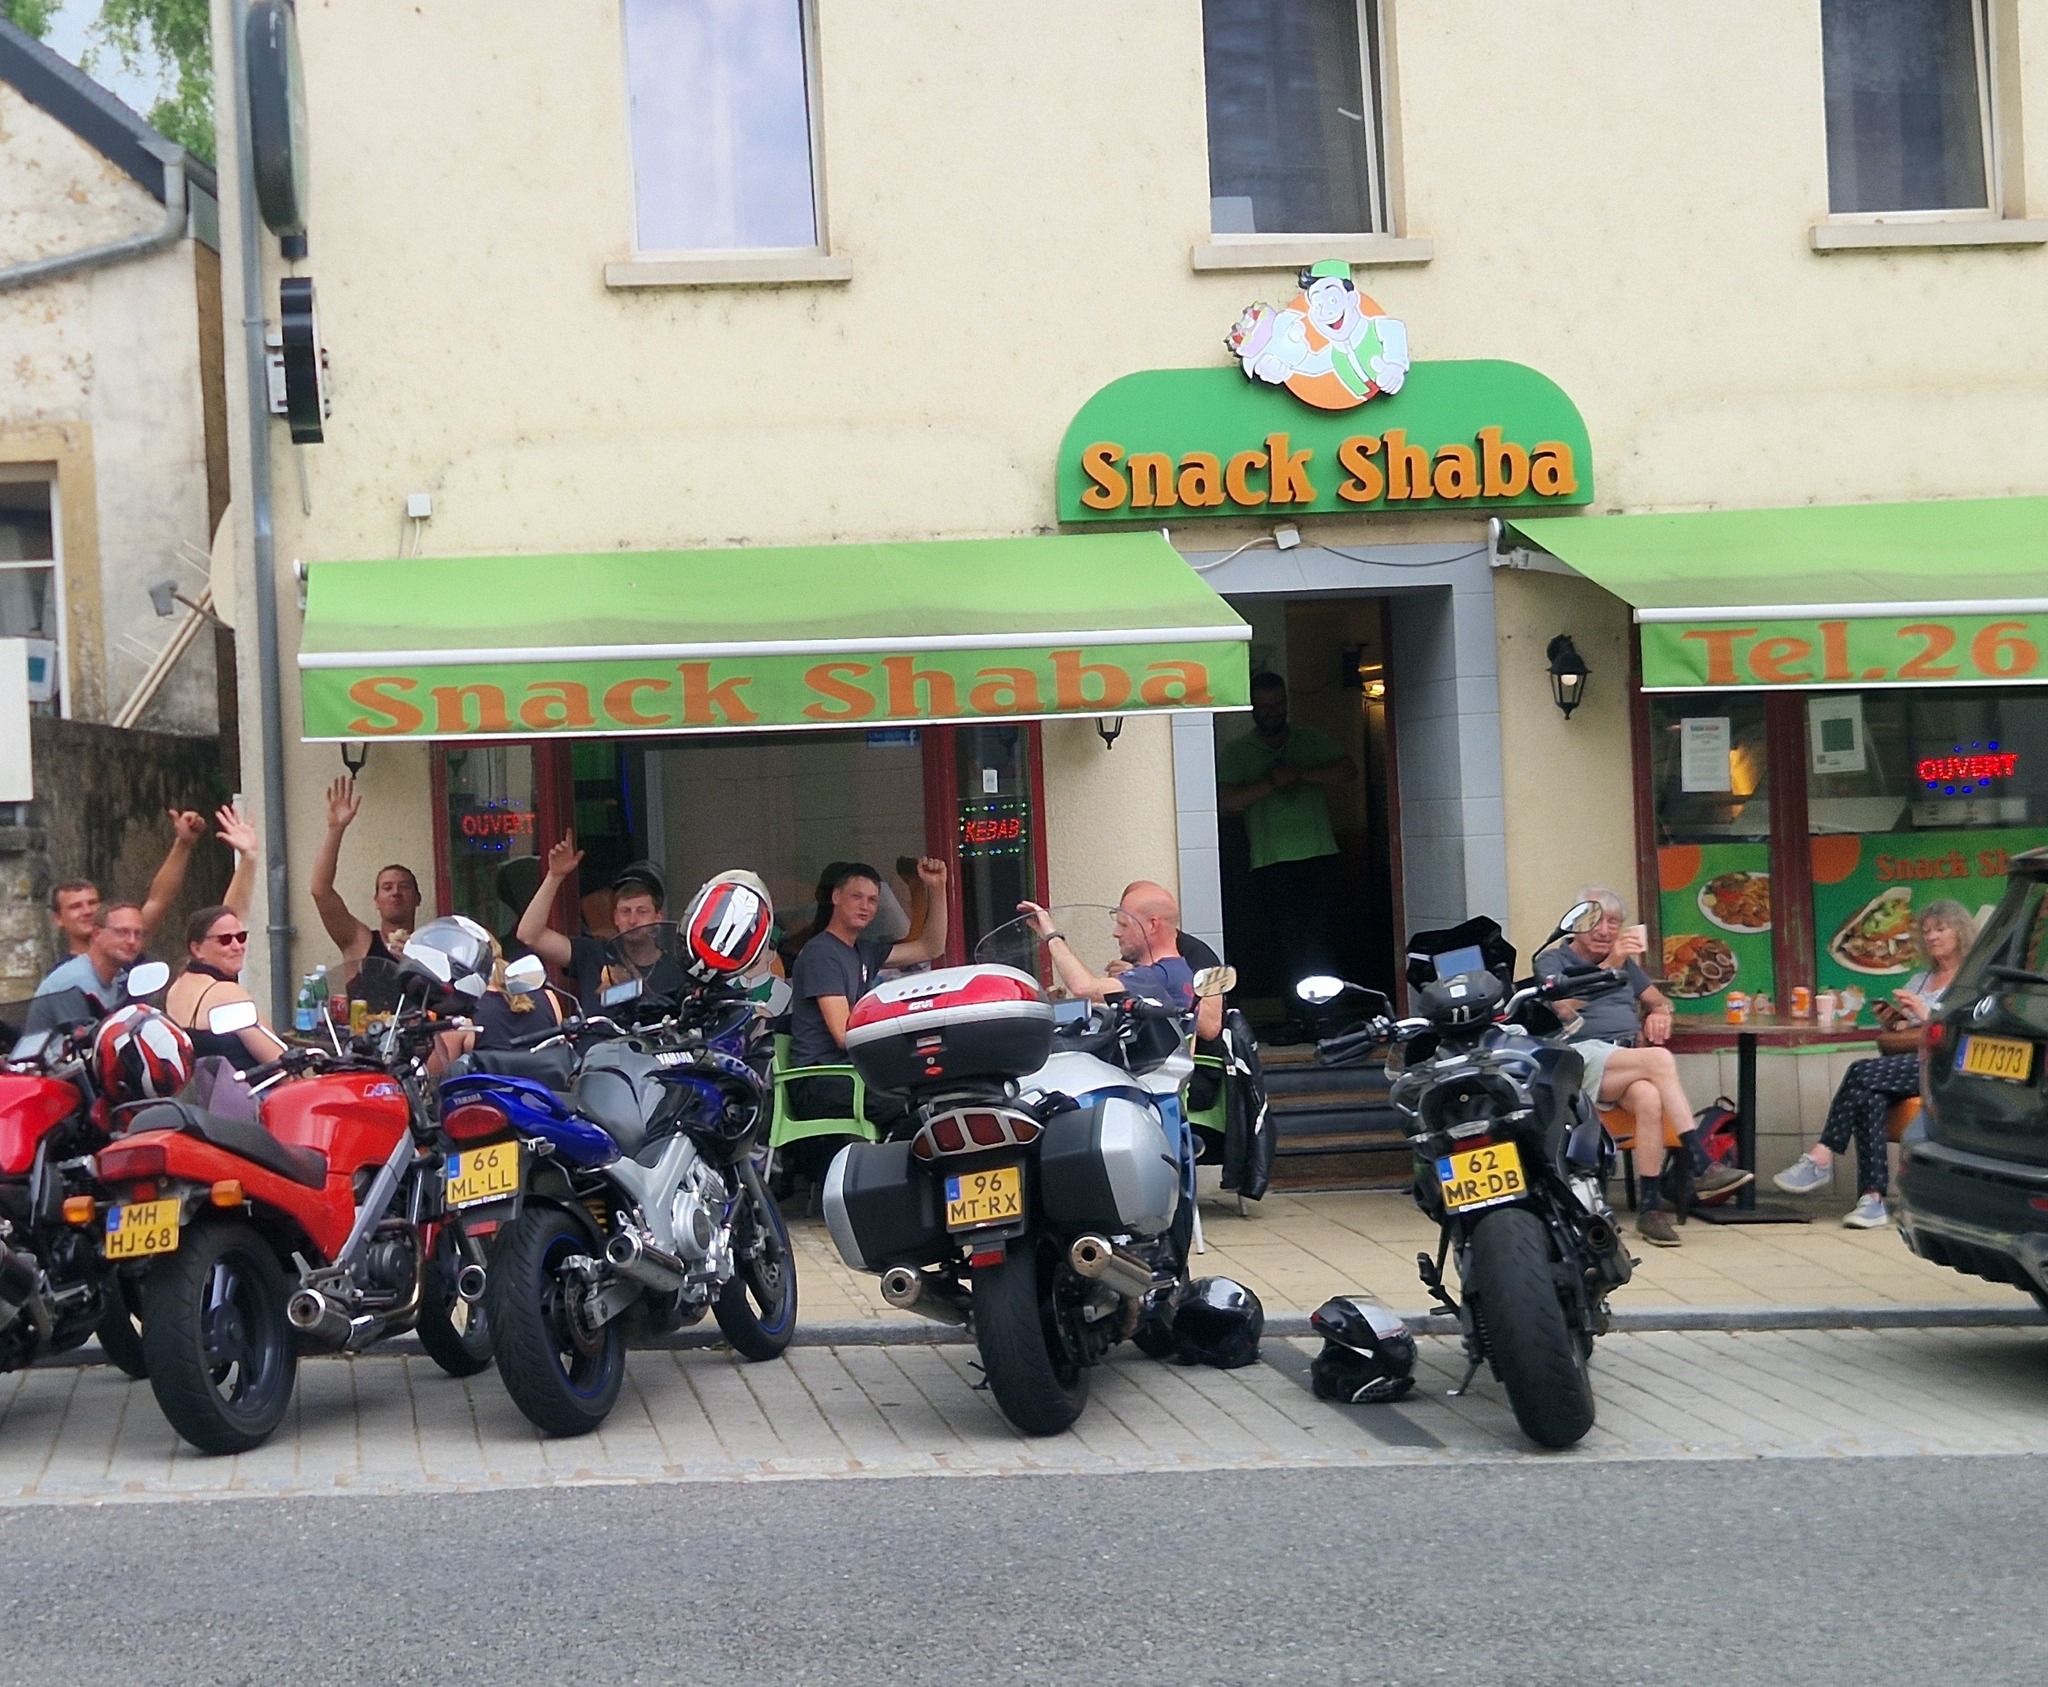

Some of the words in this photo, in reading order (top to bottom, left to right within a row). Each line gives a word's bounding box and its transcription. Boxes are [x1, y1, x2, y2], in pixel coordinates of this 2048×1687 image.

[1081, 432, 1317, 510] Snack
[1337, 425, 1578, 502] Shaba
[347, 661, 760, 735] Snack
[802, 650, 1214, 720] Shaba
[1918, 752, 2018, 781] OUVERT
[462, 812, 535, 837] OUVERT
[965, 818, 1021, 842] KEBAB
[1876, 850, 1969, 882] Snack
[473, 1149, 499, 1171] 66
[1469, 1150, 1498, 1173] 62
[974, 1172, 1002, 1195] 96
[1445, 1169, 1519, 1204] MR-DB
[127, 1205, 158, 1227] MH
